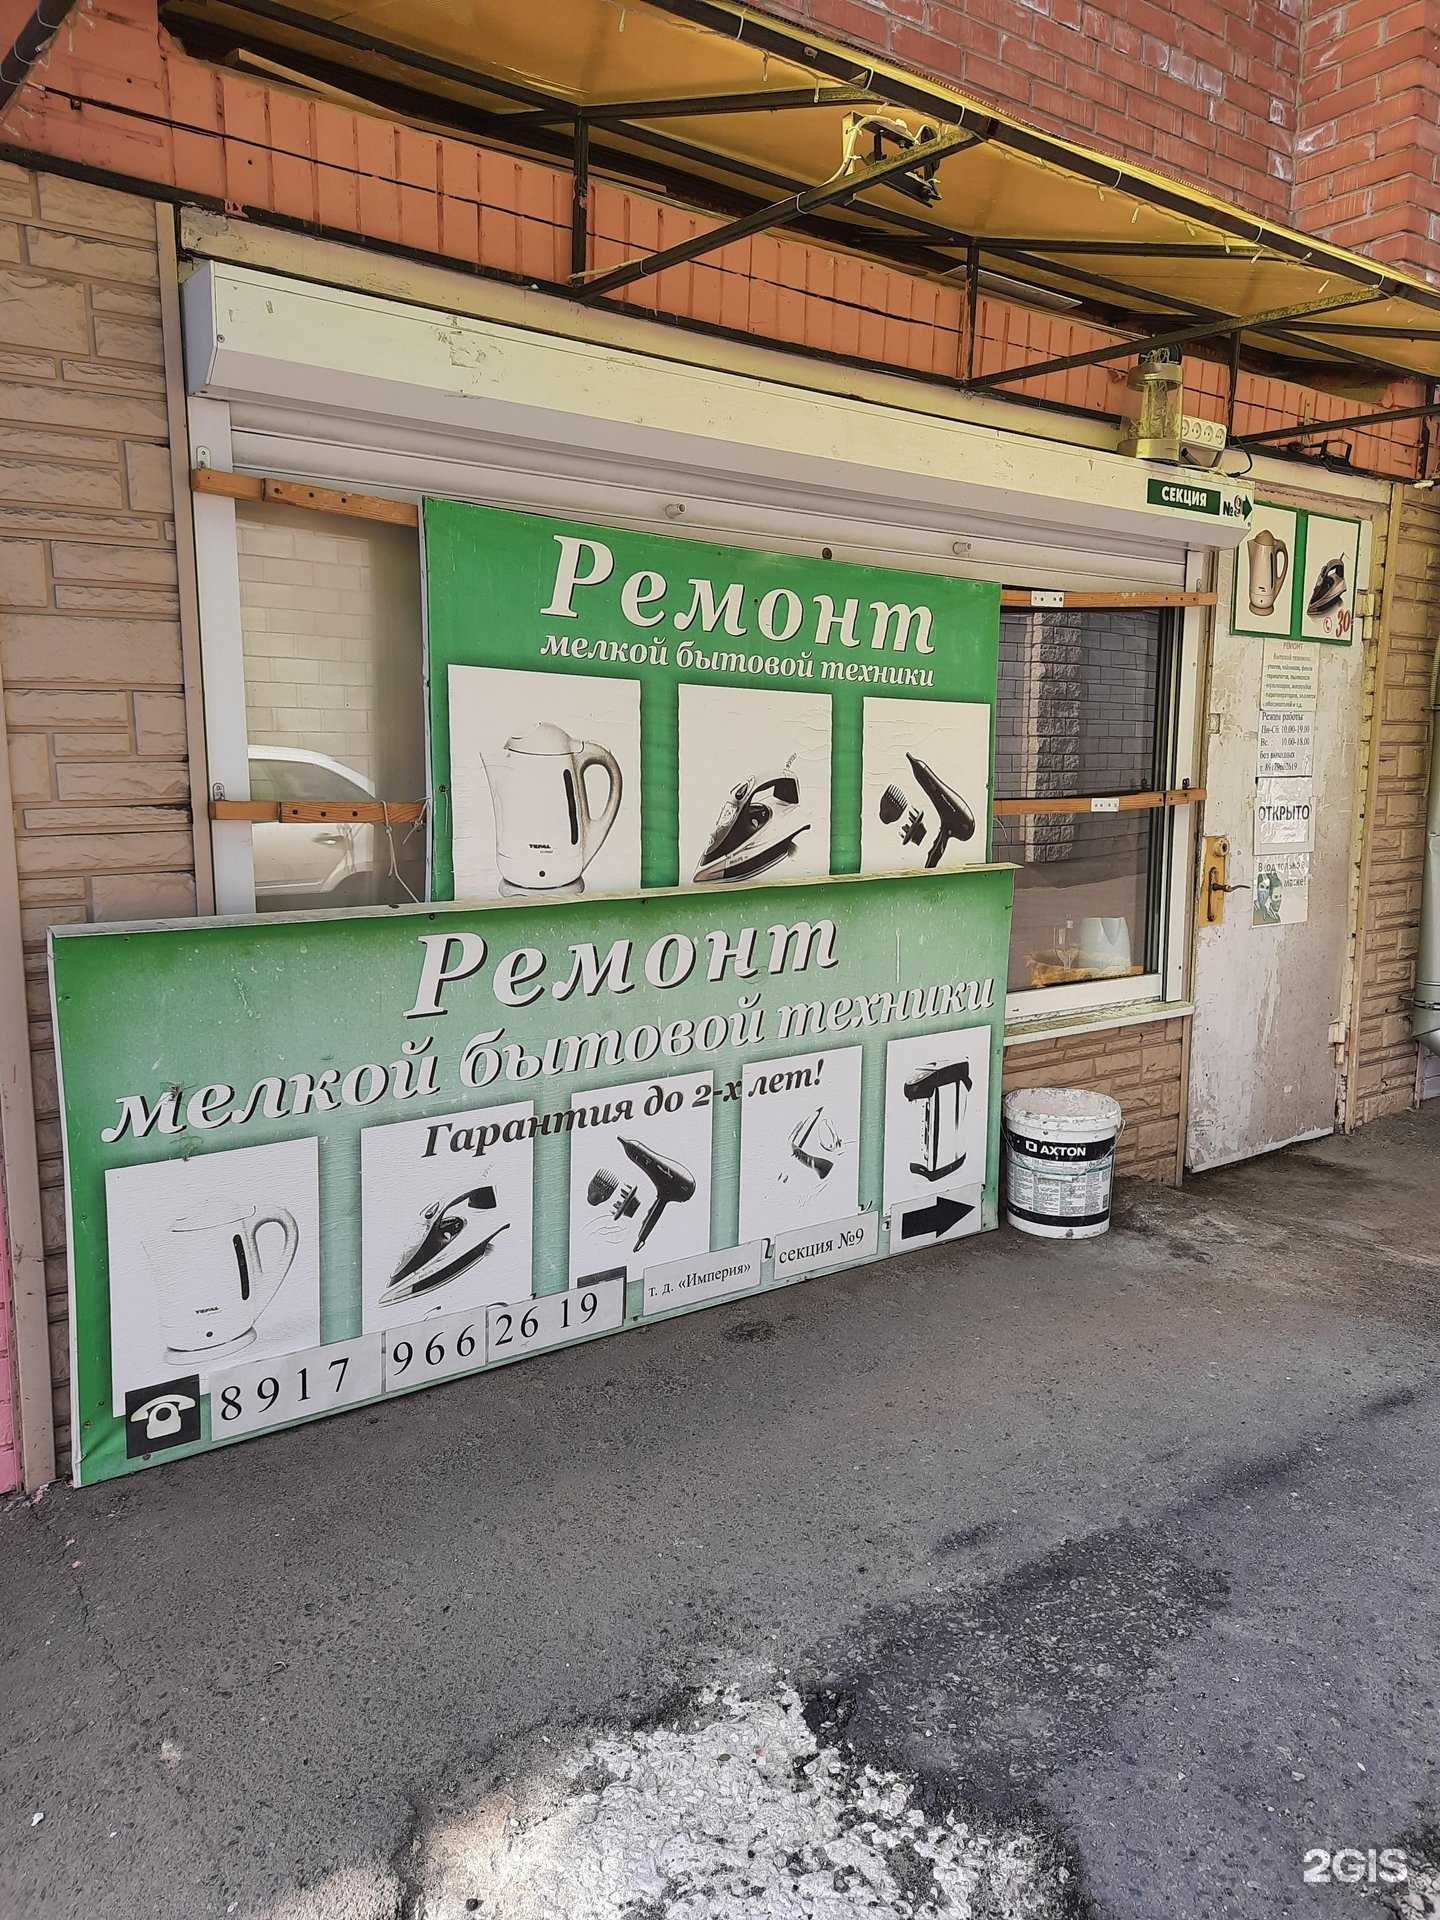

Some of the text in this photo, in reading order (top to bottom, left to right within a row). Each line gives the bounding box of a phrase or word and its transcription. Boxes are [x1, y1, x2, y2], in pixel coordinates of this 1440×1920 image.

[1162, 486, 1207, 507] СЕКЦИЯ
[540, 534, 935, 655] Ремонт
[540, 631, 935, 688] мелкой бытовой техники
[1258, 805, 1310, 821] ОТКРЫТО
[403, 917, 839, 1019] Ремонт
[101, 976, 995, 1143] мелкой бытовой техники
[421, 1059, 824, 1159] Гарантия до 2-х лет!
[1040, 1145, 1087, 1157] AXTON
[779, 1227, 864, 1265] секция №9
[678, 1263, 751, 1291] «Империя»
[219, 1358, 350, 1423] 8917
[392, 1324, 476, 1376] 966
